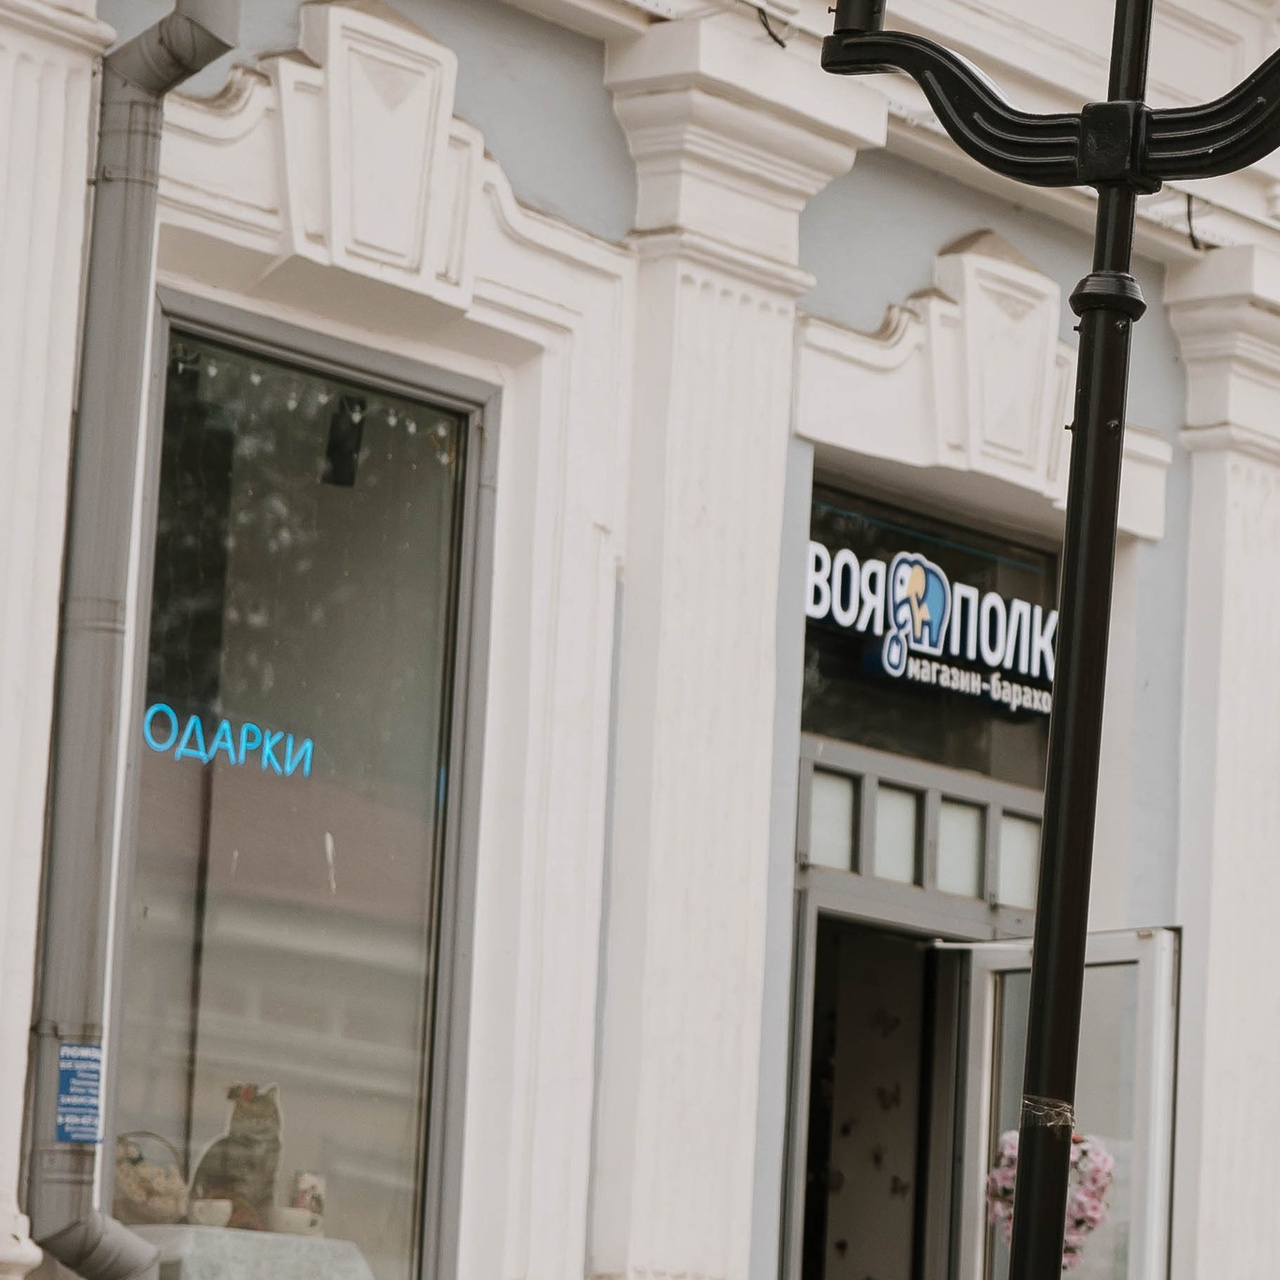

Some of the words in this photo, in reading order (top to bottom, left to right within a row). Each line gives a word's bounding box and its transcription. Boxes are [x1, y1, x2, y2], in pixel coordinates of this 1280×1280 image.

[805, 540, 886, 636] ВОЯ
[950, 581, 1058, 682] ПОЛК
[143, 702, 314, 779] ОДАРКИ
